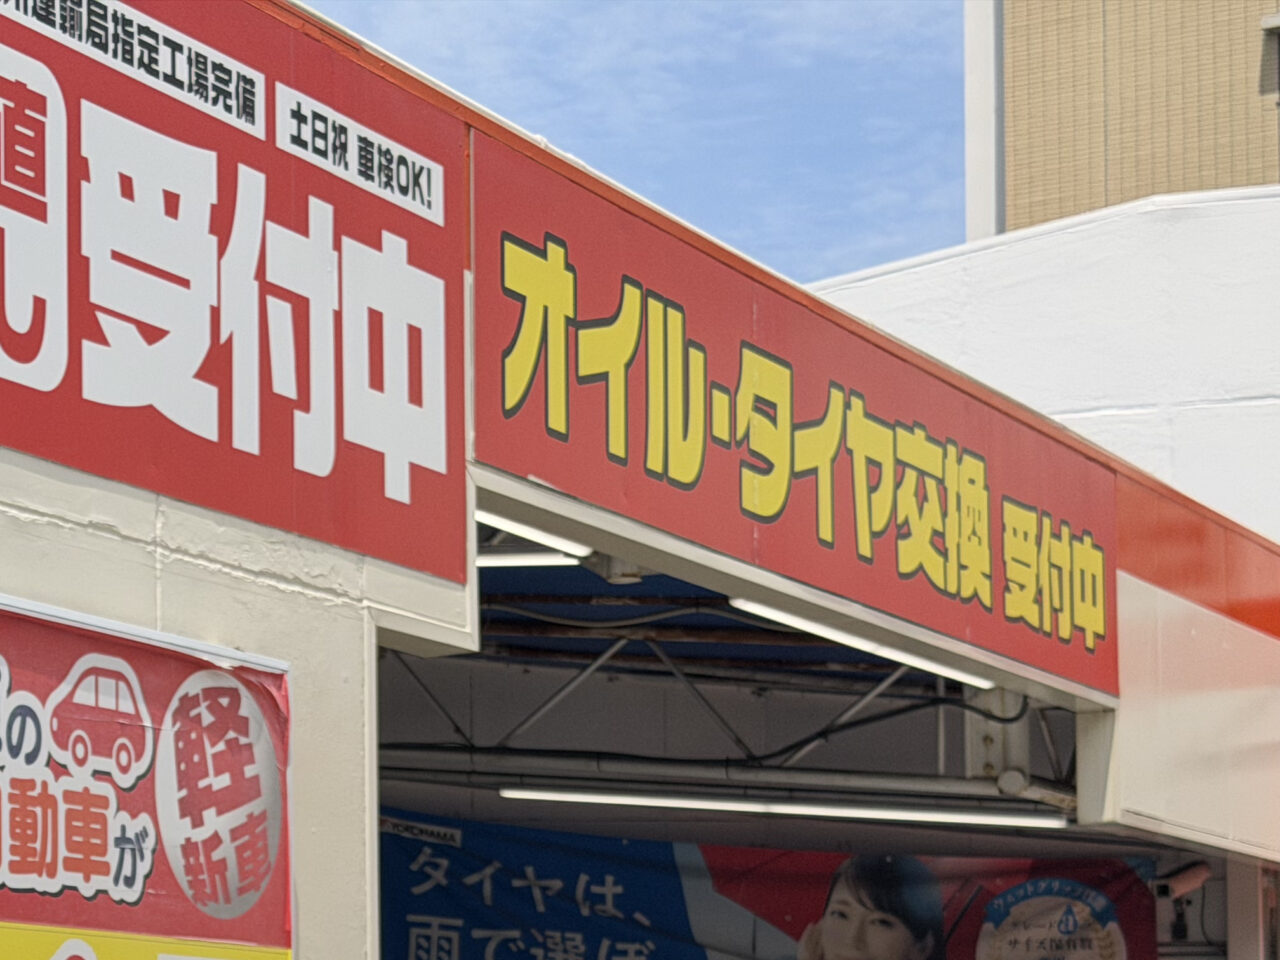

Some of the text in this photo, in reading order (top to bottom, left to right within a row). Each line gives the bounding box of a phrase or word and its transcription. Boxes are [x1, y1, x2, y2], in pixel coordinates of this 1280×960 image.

[290, 101, 432, 210] 土日祝 車検OK!
[80, 99, 446, 505] 受付中
[501, 230, 1106, 656] オイル・タイヤ交換 受付中
[409, 846, 651, 927] タイヤは、
